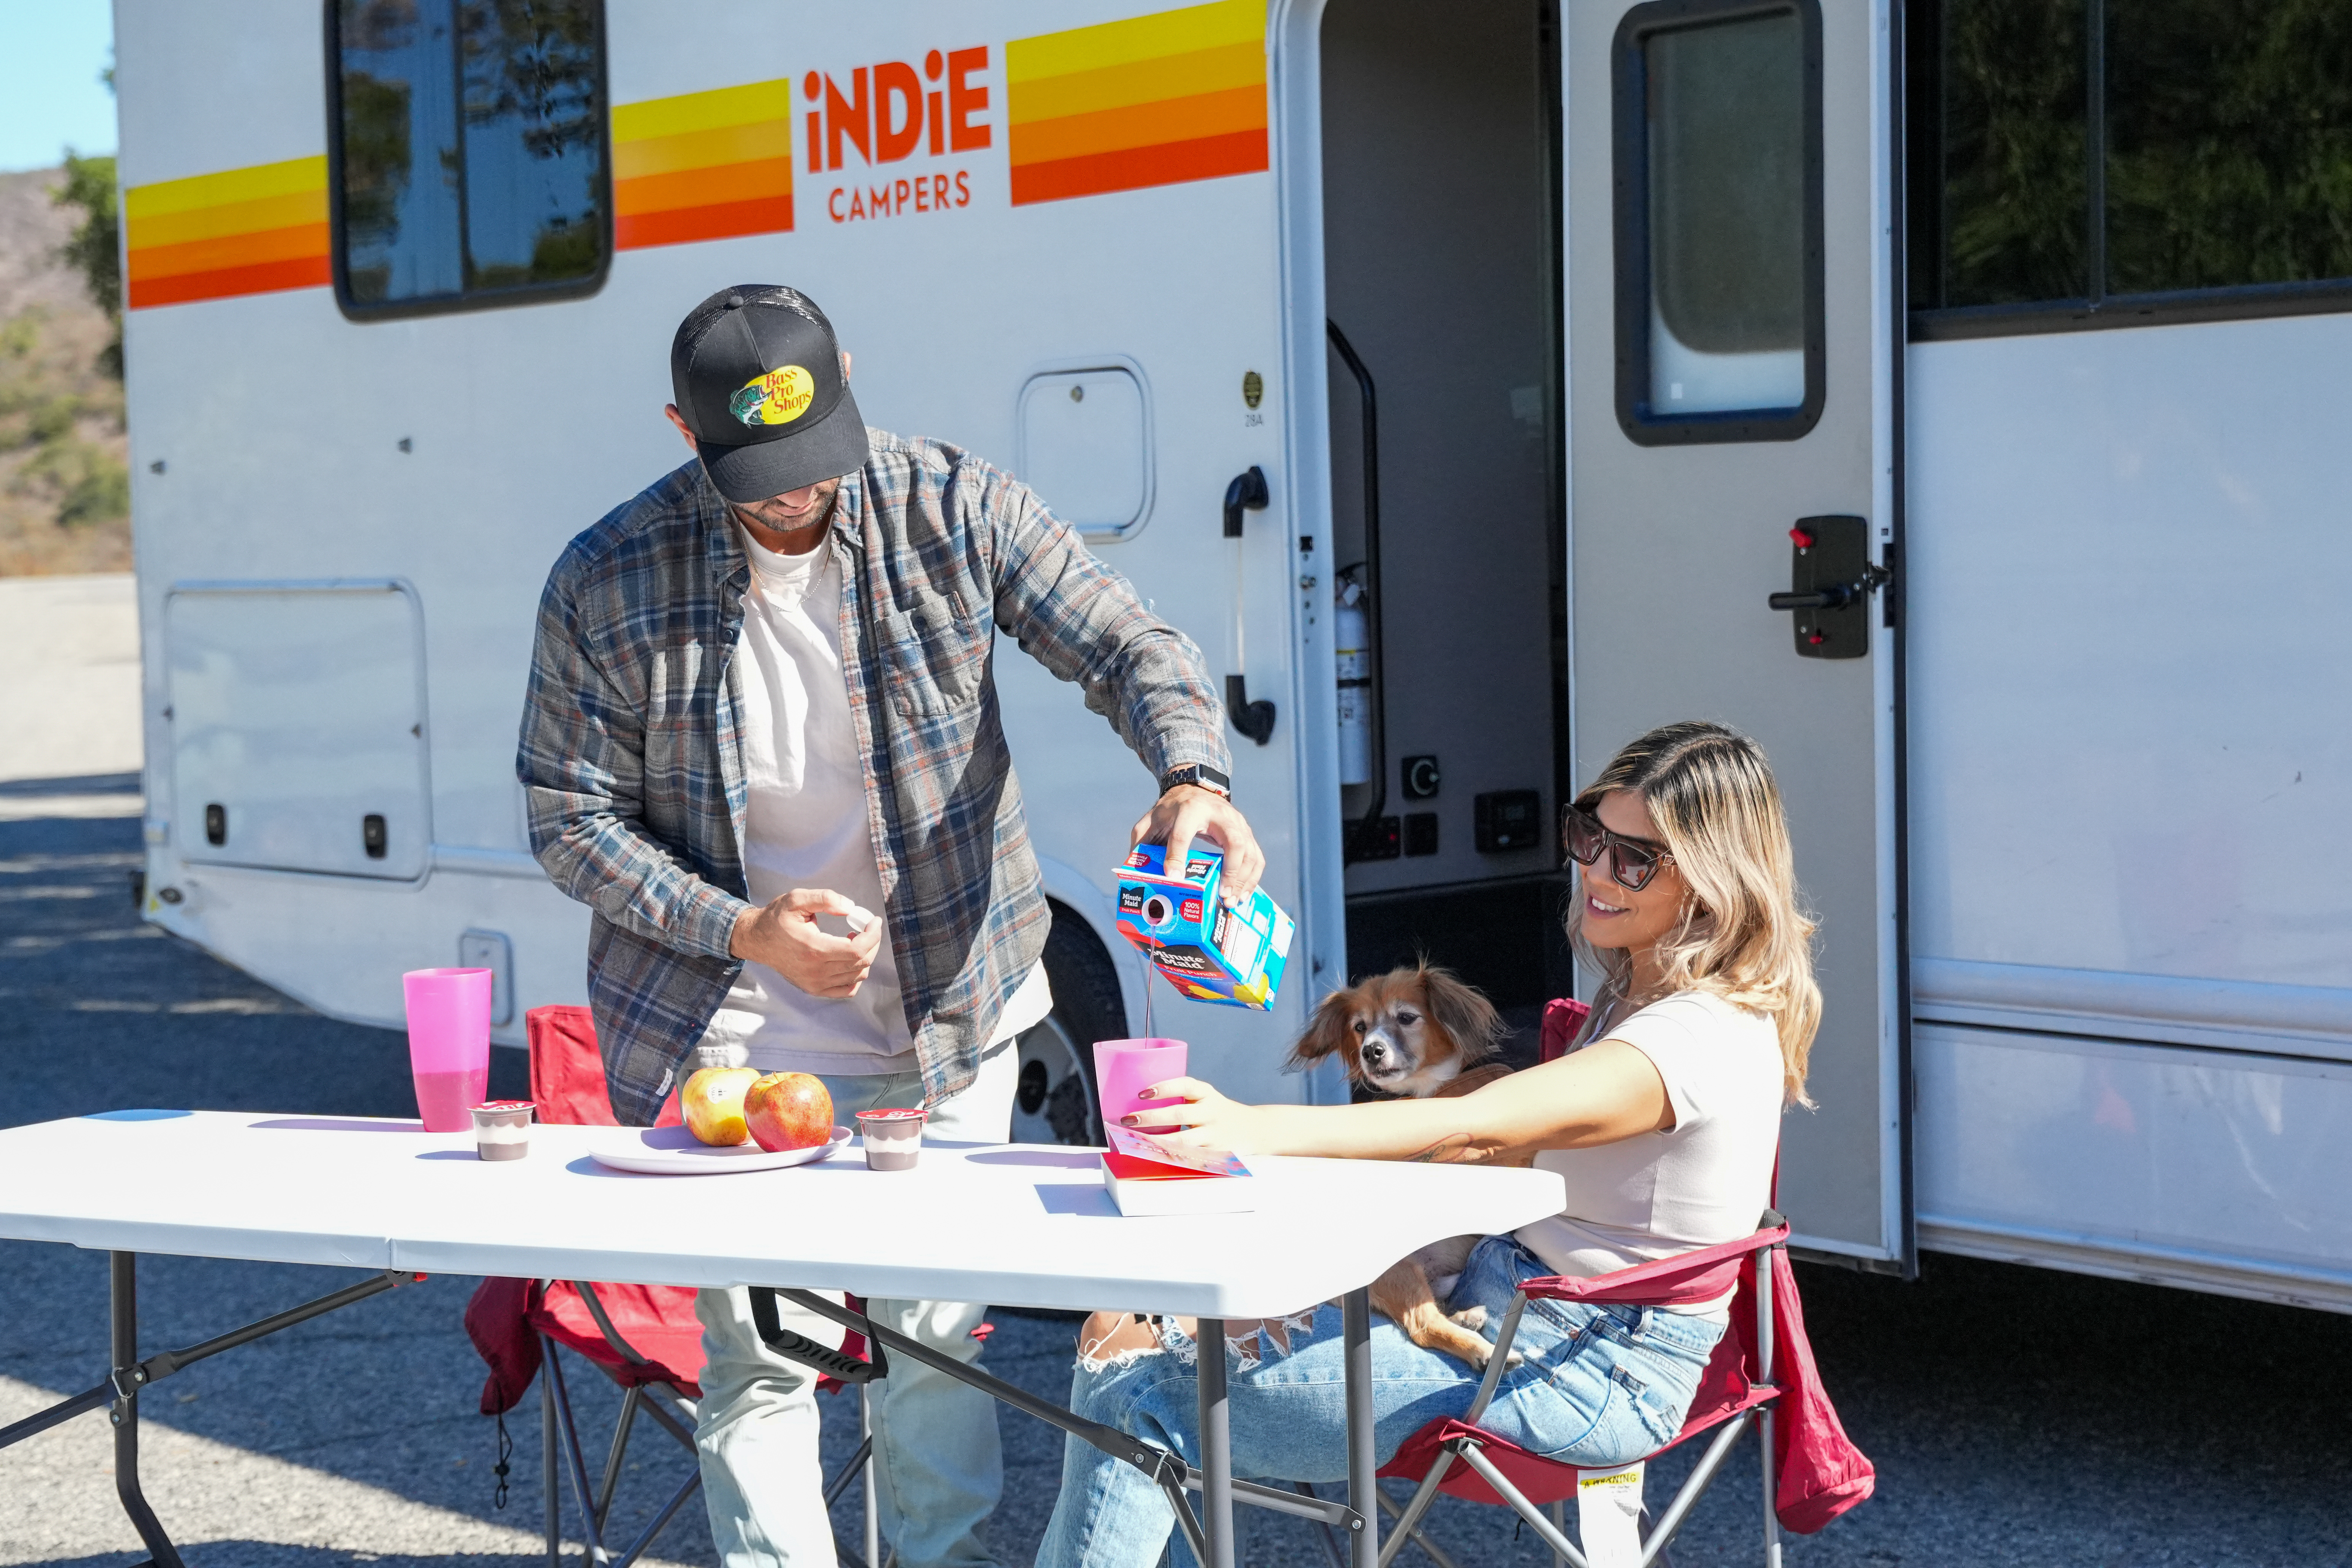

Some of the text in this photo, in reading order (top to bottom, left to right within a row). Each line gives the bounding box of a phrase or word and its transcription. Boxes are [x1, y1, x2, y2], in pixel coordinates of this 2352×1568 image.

[828, 171, 971, 223] CAMPERS
[766, 368, 797, 389] Bass
[771, 385, 793, 401] Pro
[773, 391, 811, 414] Shops
[1122, 893, 1141, 902] Minute
[1213, 908, 1223, 944] Minute
[1217, 916, 1226, 943] Maid
[1147, 948, 1205, 963] Minute
[1160, 957, 1204, 969] Maid
[1164, 965, 1187, 974] Fruit
[1593, 1473, 1636, 1486] WARNING
